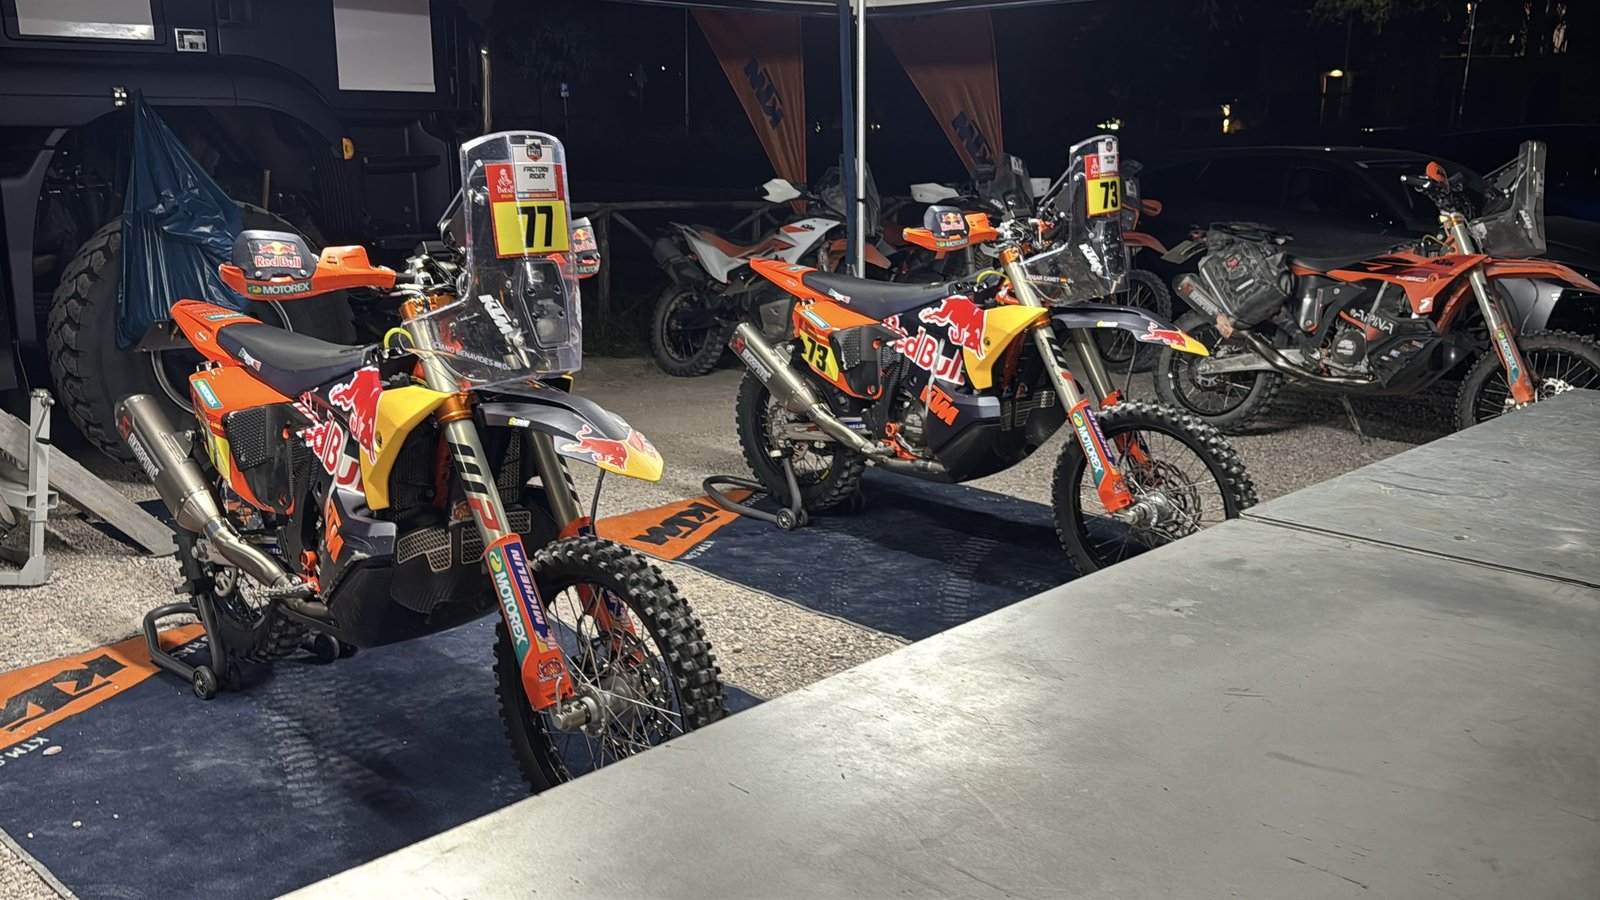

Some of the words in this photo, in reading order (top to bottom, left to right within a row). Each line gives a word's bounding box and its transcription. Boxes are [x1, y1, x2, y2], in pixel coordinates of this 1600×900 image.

[1100, 181, 1118, 209] 73
[516, 205, 552, 248] 77
[255, 255, 278, 267] Red
[279, 256, 302, 268] Bull
[262, 282, 310, 294] MOTOREX
[478, 294, 513, 335] KTM
[456, 348, 494, 367] BENAVIDES
[806, 336, 829, 372] 73
[919, 384, 960, 426] KTM
[1077, 425, 1105, 474] MOTOREX
[631, 501, 721, 546] KTM
[510, 548, 545, 626] MICHELIN
[494, 570, 529, 646] MOTOREX
